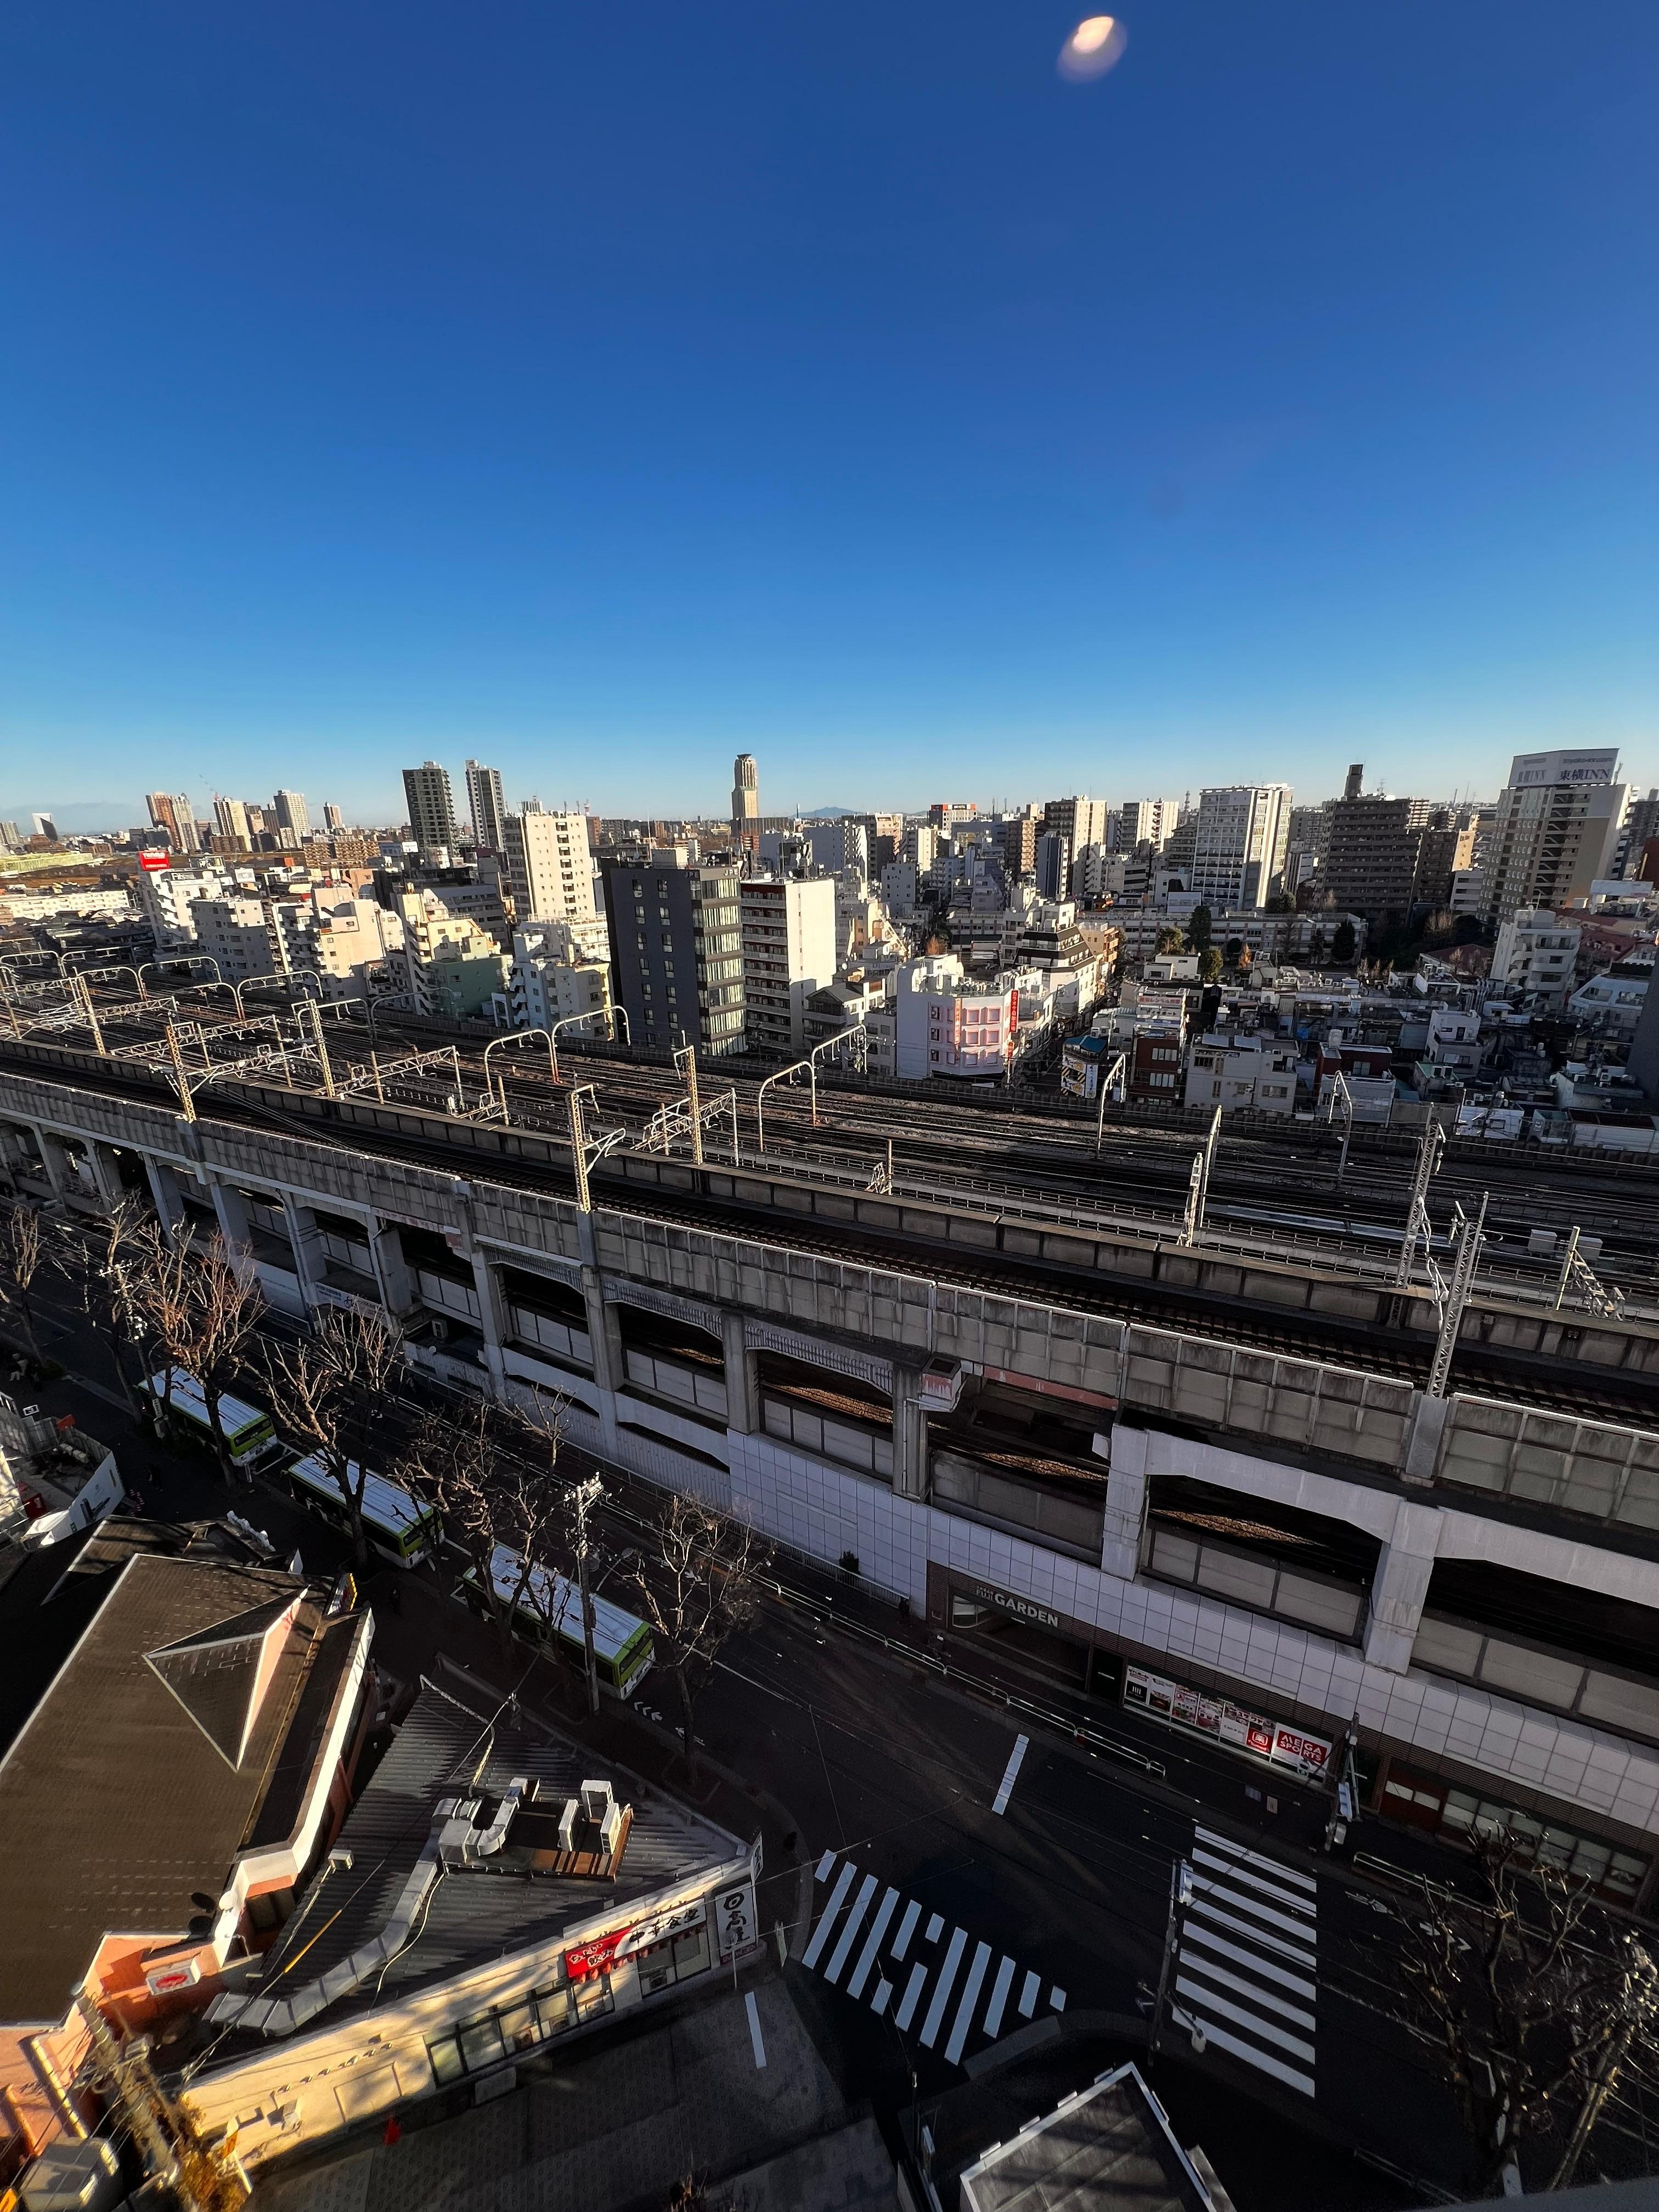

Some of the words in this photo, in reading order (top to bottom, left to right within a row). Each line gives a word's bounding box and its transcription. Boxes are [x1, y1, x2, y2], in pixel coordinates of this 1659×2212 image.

[1559, 769, 1611, 781] 東横INN
[994, 1593, 1058, 1628] GARDEN
[1280, 1741, 1322, 1761] SPORTS
[1281, 1734, 1322, 1756] MEGA
[628, 1908, 700, 1949] 中華食堂
